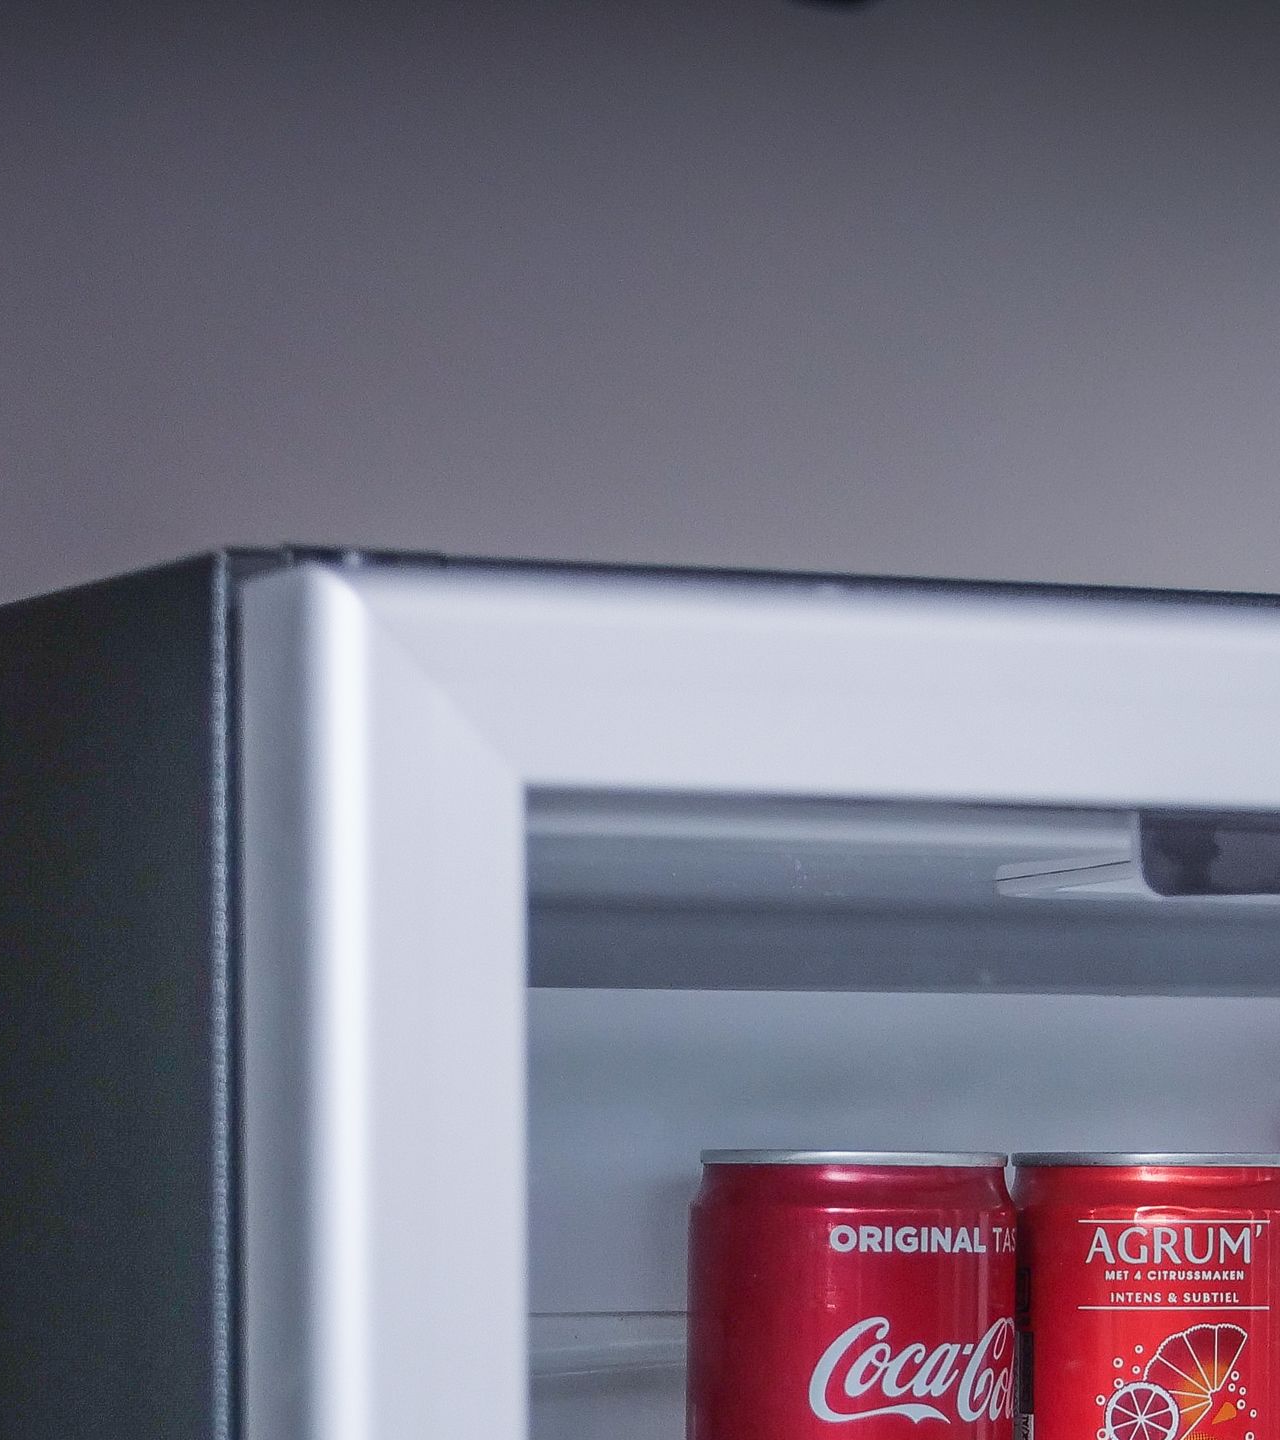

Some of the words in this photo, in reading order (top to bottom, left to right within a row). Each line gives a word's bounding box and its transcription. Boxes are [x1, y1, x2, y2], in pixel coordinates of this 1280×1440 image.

[829, 1225, 987, 1254] ORIGINAL
[1104, 1270, 1129, 1281] MET
[1133, 1270, 1142, 1281] 4
[1147, 1270, 1245, 1281] CITRUSSMAKEN
[1109, 1292, 1162, 1303] INTENS
[1167, 1292, 1178, 1303] &
[1183, 1292, 1240, 1303] SUBTIEL
[808, 1316, 1016, 1424] Coca-Col
